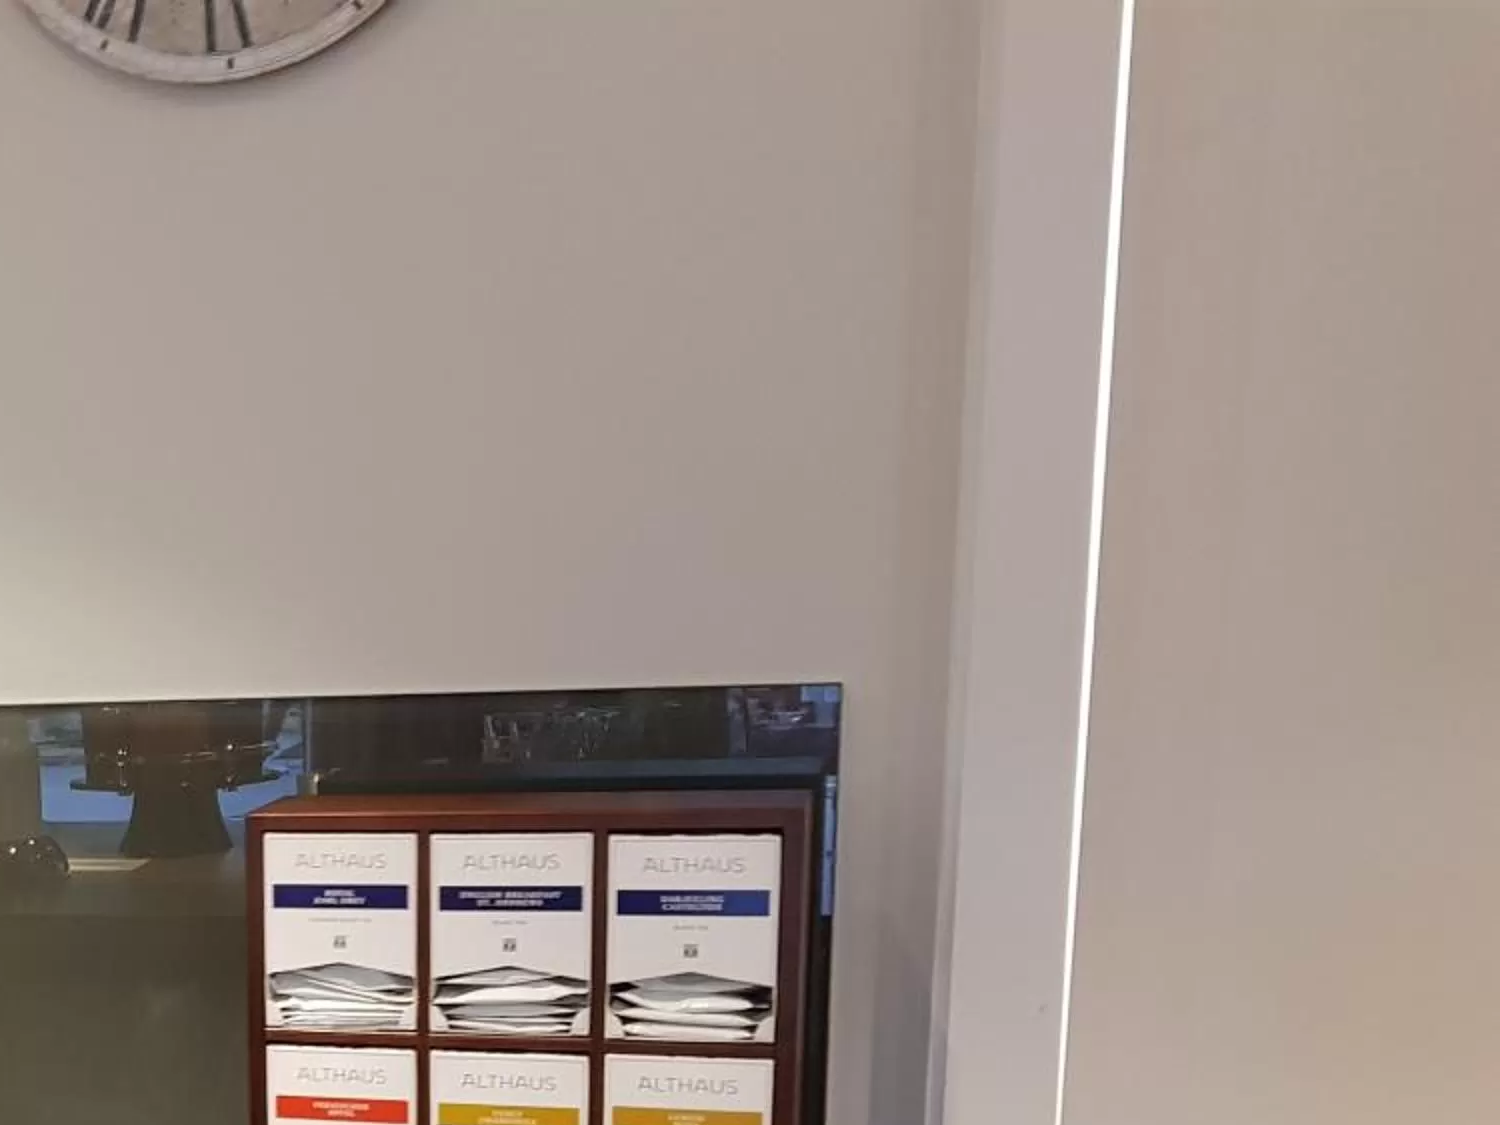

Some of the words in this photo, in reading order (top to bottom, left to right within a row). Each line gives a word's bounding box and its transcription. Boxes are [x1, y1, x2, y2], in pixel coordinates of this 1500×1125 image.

[295, 852, 387, 868] ALTHAUS
[463, 853, 562, 870] ALTHAUS
[643, 857, 746, 873] ALTHAUS
[296, 1067, 387, 1085] ALTHAUS
[461, 1073, 557, 1091] ALTHAUS
[637, 1076, 739, 1095] ALTHAUS
